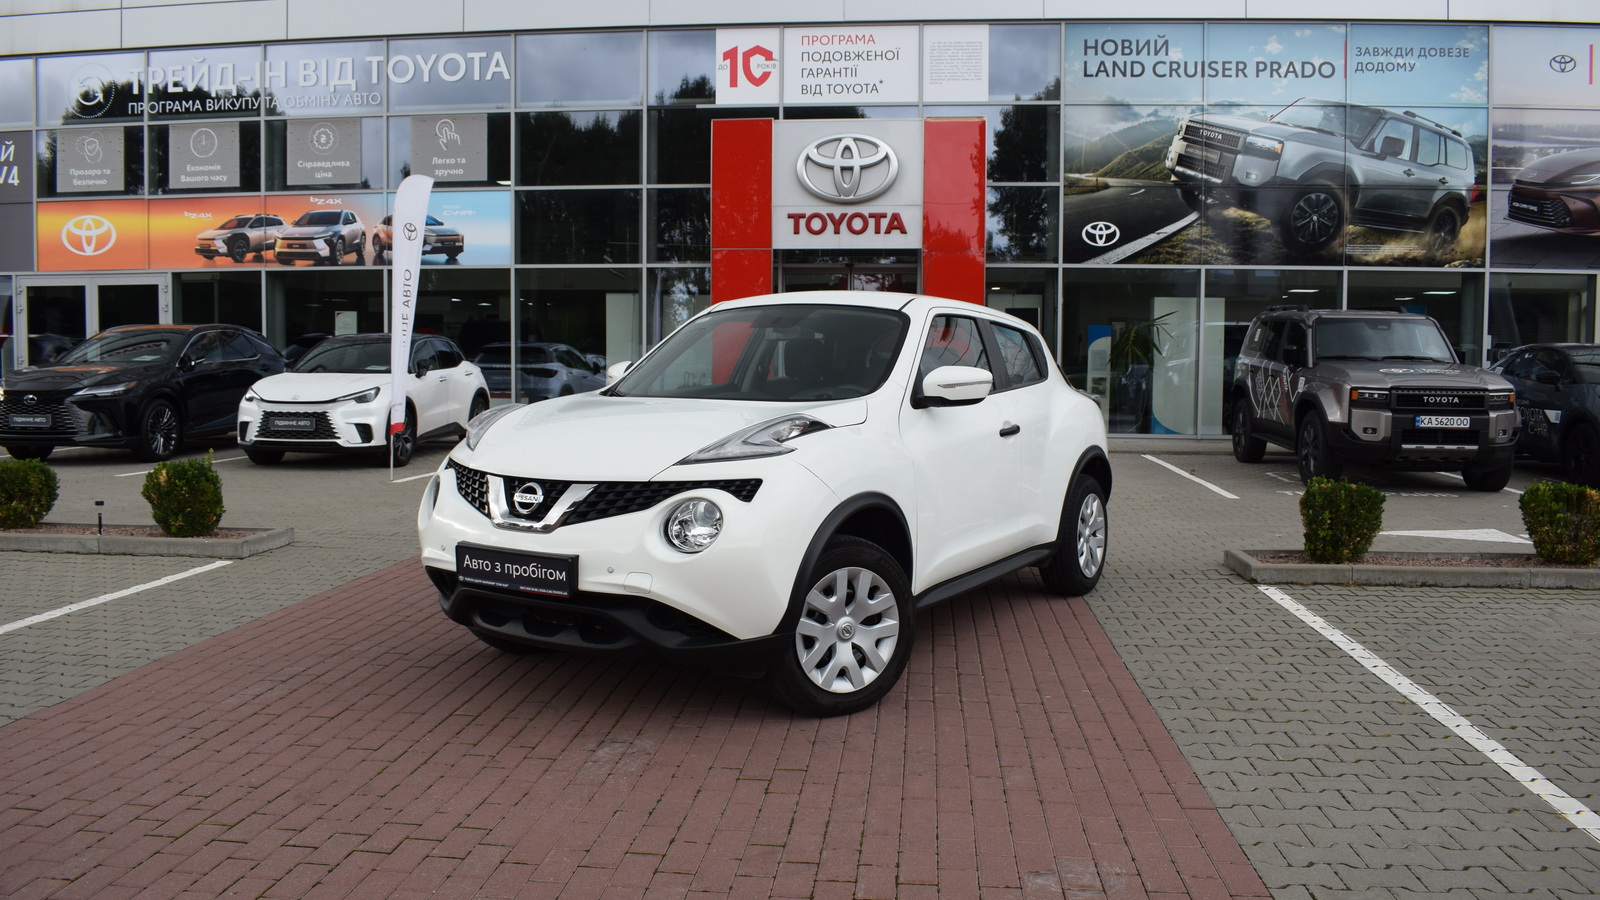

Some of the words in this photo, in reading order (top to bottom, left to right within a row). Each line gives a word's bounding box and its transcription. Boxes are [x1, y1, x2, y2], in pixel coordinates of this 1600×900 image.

[801, 34, 876, 46] ПРОГРАМА
[1083, 34, 1169, 56] НОВИЙ
[801, 47, 901, 64] ПОДОВЖЕНОЇ
[1355, 47, 1414, 59] ЗАВЖДИ
[1417, 47, 1470, 59] ДОВЕЗЕ
[128, 57, 287, 97] ТРЕЙД-ІН
[299, 57, 357, 92] ВІД
[365, 51, 511, 84] TOYOTA
[801, 65, 859, 79] ГАРАНТІЇ
[1083, 60, 1146, 78] LAND
[1152, 60, 1248, 78] CRUISER
[1255, 61, 1336, 79] PRADO
[1354, 62, 1416, 74] ДОДОМУ
[801, 84, 823, 96] ВІД
[128, 100, 202, 114] ПРОГРАМА
[206, 97, 261, 112] ВИКУПУ
[265, 96, 278, 109] ТА
[285, 94, 341, 109] ОБМІНУ
[343, 92, 381, 106] АВТО
[1199, 129, 1222, 140] TOYOTA
[297, 160, 350, 169] Справедлива
[431, 157, 456, 165] Легко
[69, 168, 102, 177] Прозоро
[186, 164, 221, 172] Економія
[434, 169, 464, 177] зручно
[180, 174, 209, 182] Вашого
[211, 175, 228, 183] часу
[315, 171, 333, 179] ціна
[73, 178, 107, 186] безпечно
[787, 212, 908, 236] TOYOTA
[402, 269, 412, 309] АВТО
[1420, 417, 1435, 426] KA
[1435, 417, 1455, 426] 5620
[1528, 421, 1548, 436] C-HR
[463, 554, 492, 571] Авто
[494, 563, 501, 573] з
[504, 563, 566, 582] пробігом
